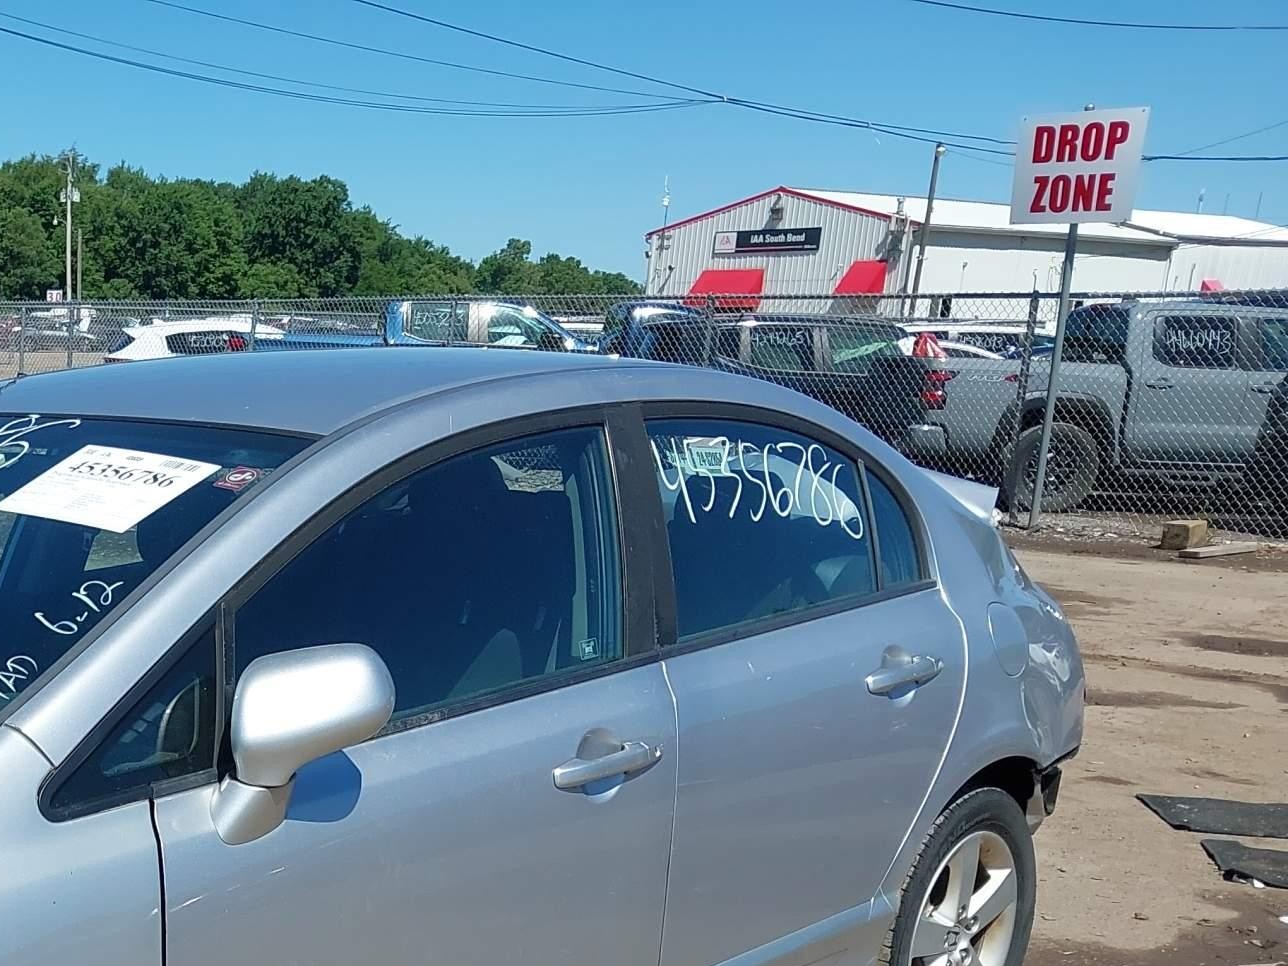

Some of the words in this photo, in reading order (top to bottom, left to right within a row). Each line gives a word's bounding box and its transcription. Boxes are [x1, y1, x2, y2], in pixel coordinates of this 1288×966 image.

[1031, 120, 1131, 164] DROP
[1029, 172, 1117, 214] ZONE
[750, 234, 764, 244] IAA
[765, 233, 786, 243] South
[786, 231, 807, 243] Bend
[68, 460, 182, 489] 45356786
[650, 435, 865, 540] 45356786
[33, 580, 125, 635] 6-12
